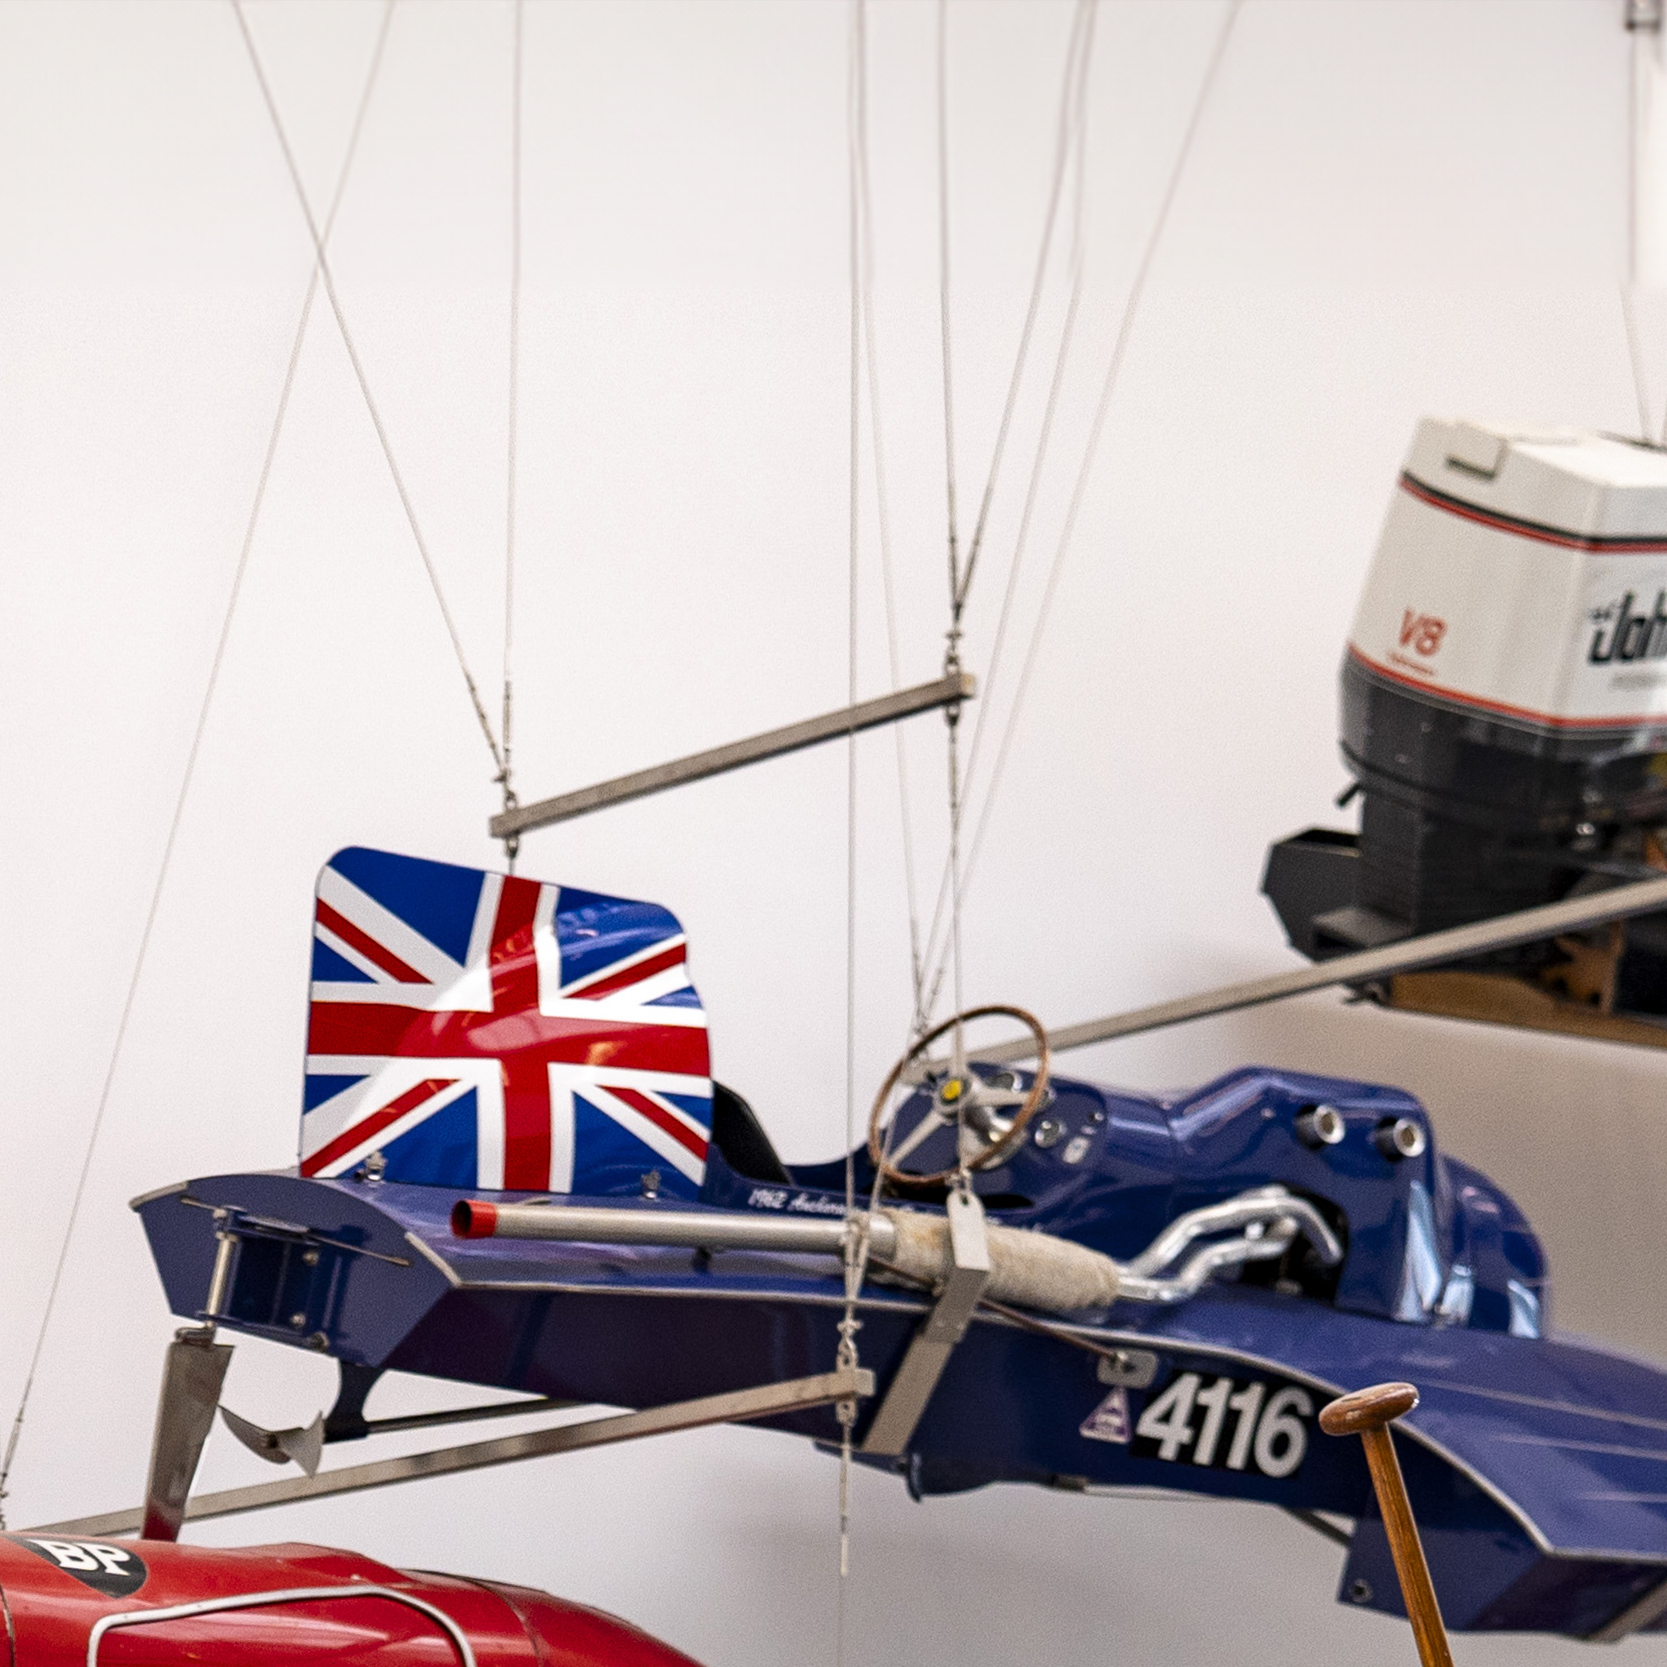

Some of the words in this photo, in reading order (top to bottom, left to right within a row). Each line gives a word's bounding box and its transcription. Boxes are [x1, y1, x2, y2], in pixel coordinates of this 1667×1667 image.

[1399, 607, 1447, 656] V8
[1136, 1372, 1314, 1478] 4116
[26, 1539, 131, 1576] BP
